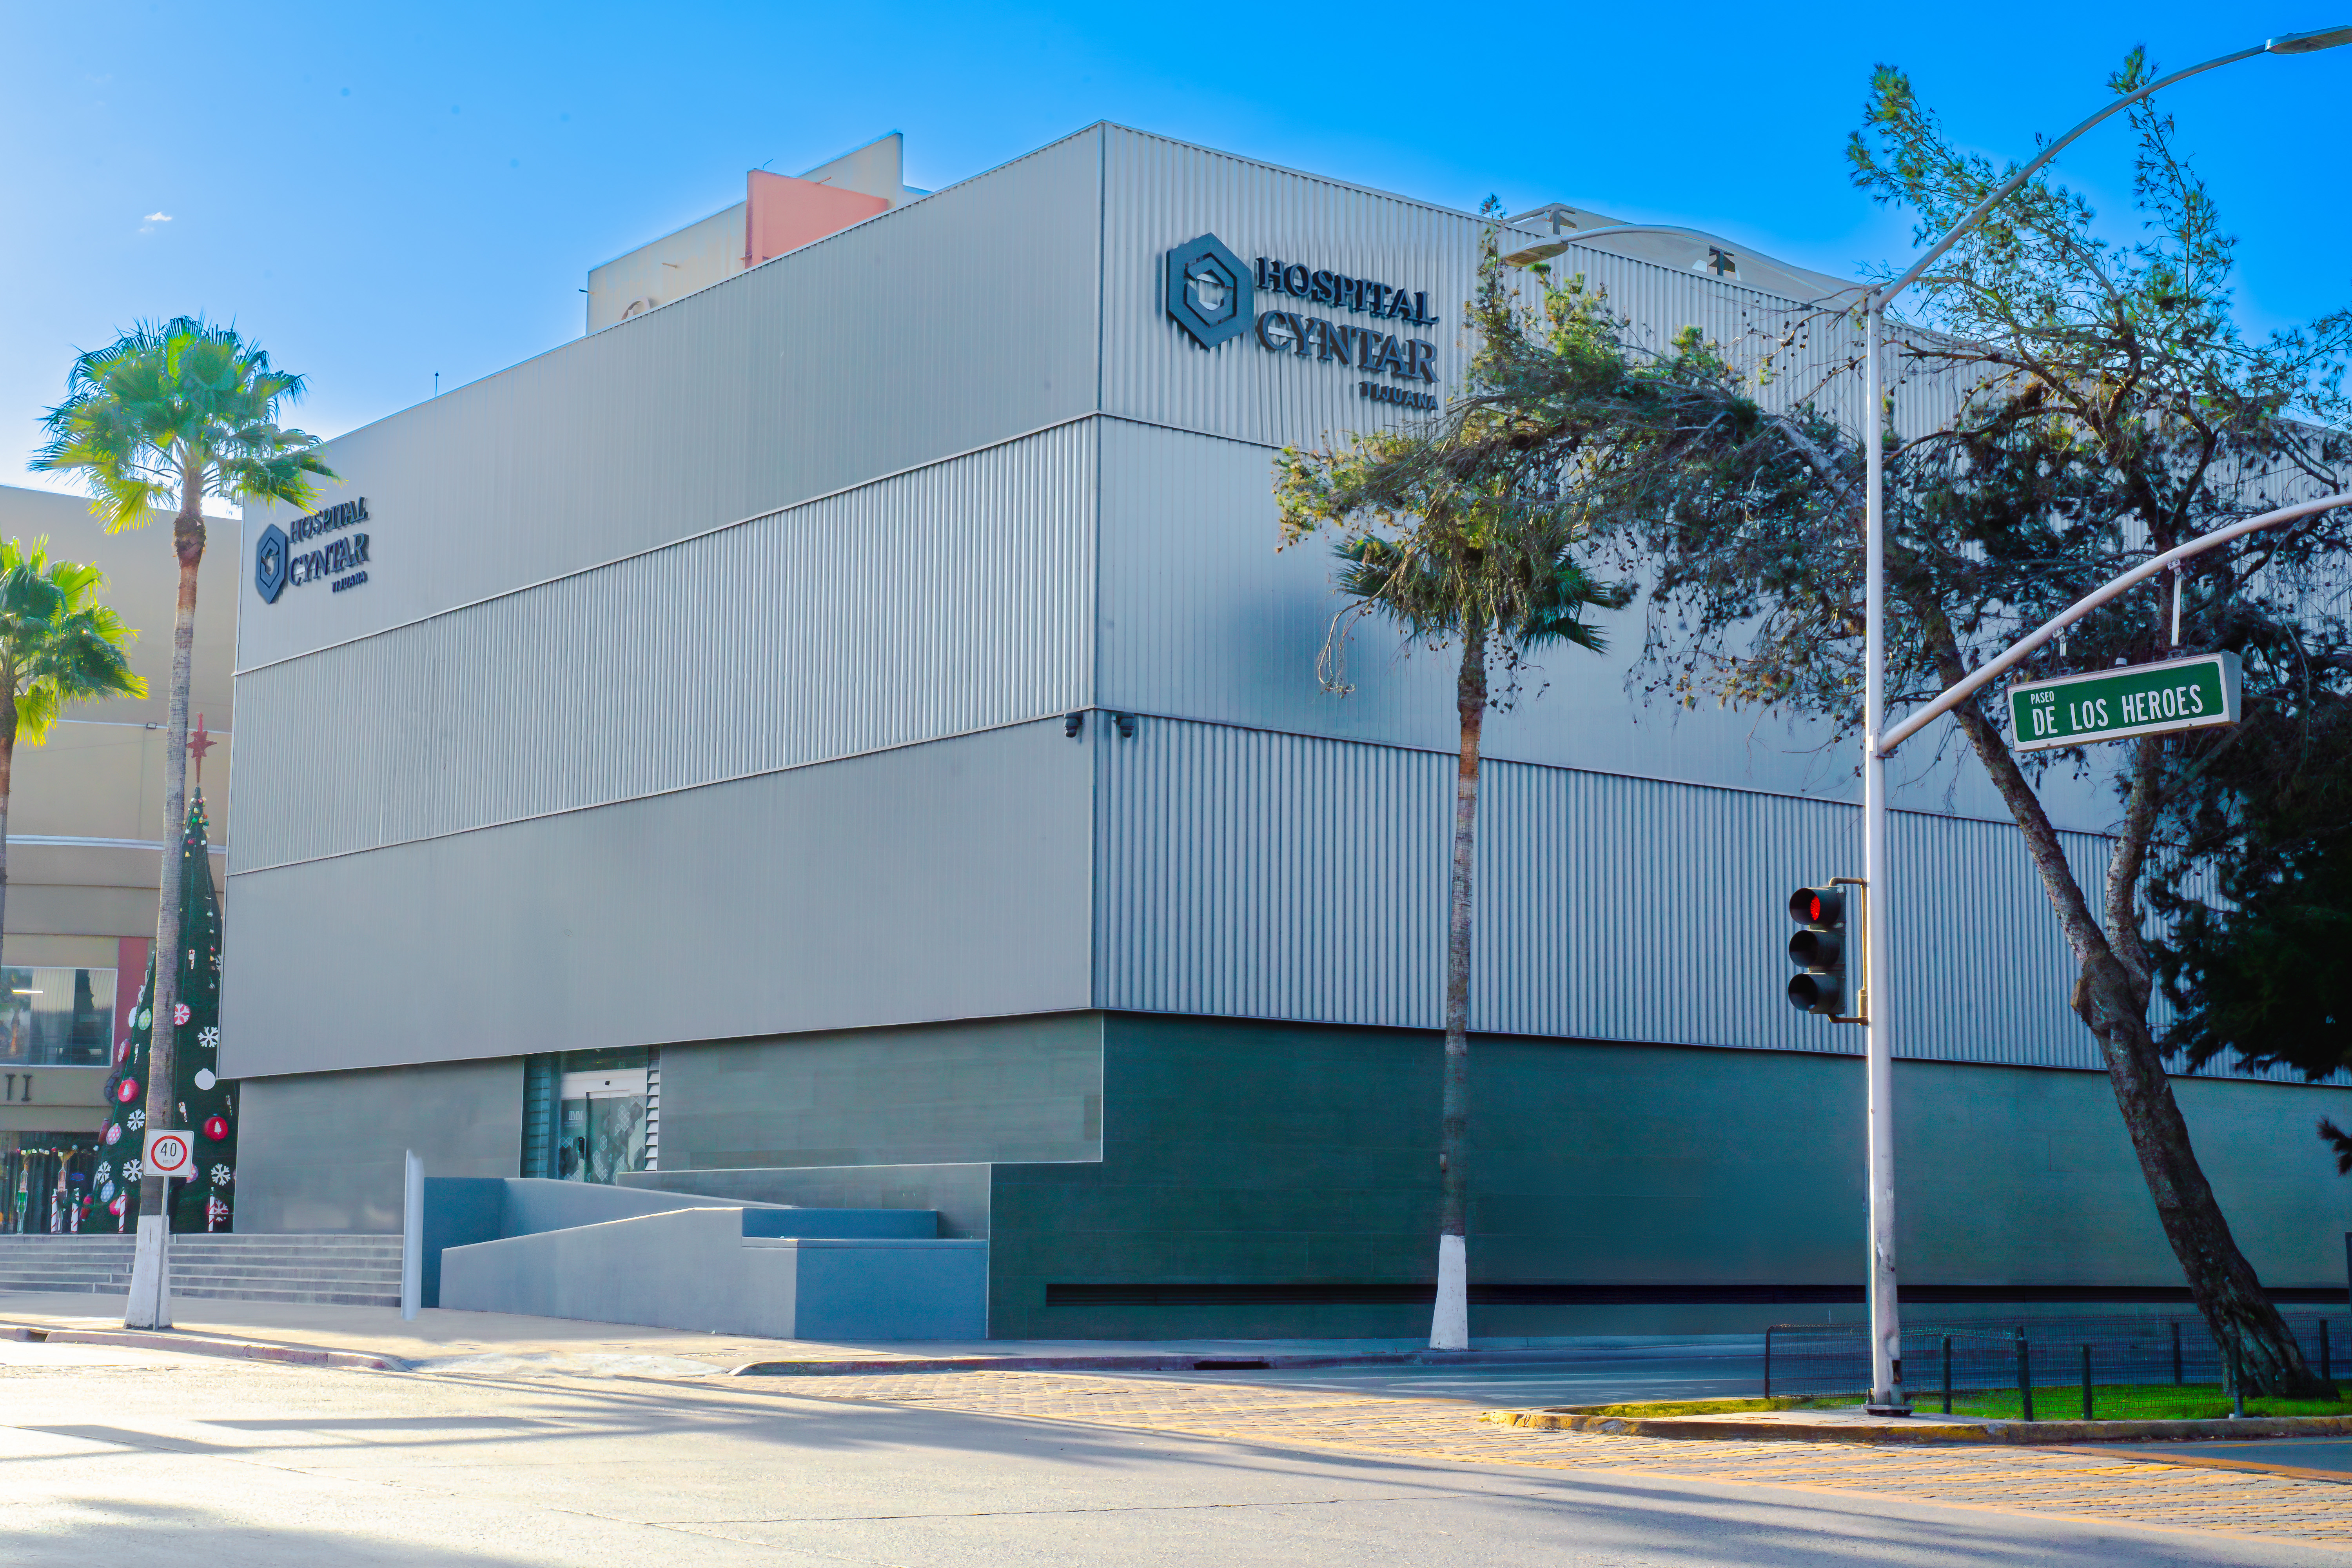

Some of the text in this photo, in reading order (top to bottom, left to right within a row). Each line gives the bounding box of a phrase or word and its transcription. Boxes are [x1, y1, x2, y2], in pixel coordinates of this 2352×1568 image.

[1256, 256, 1439, 325] HOSPITAL
[1258, 310, 1440, 383] CYNTAR
[1362, 381, 1439, 410] TIJUANA
[289, 496, 368, 543] HOSPITAL
[289, 533, 369, 586] CYNTAR
[331, 570, 368, 592] TIJUANA
[2030, 691, 2054, 705] PASEO
[2032, 684, 2203, 736] DE LOS HEROES
[160, 1142, 177, 1157] 40
